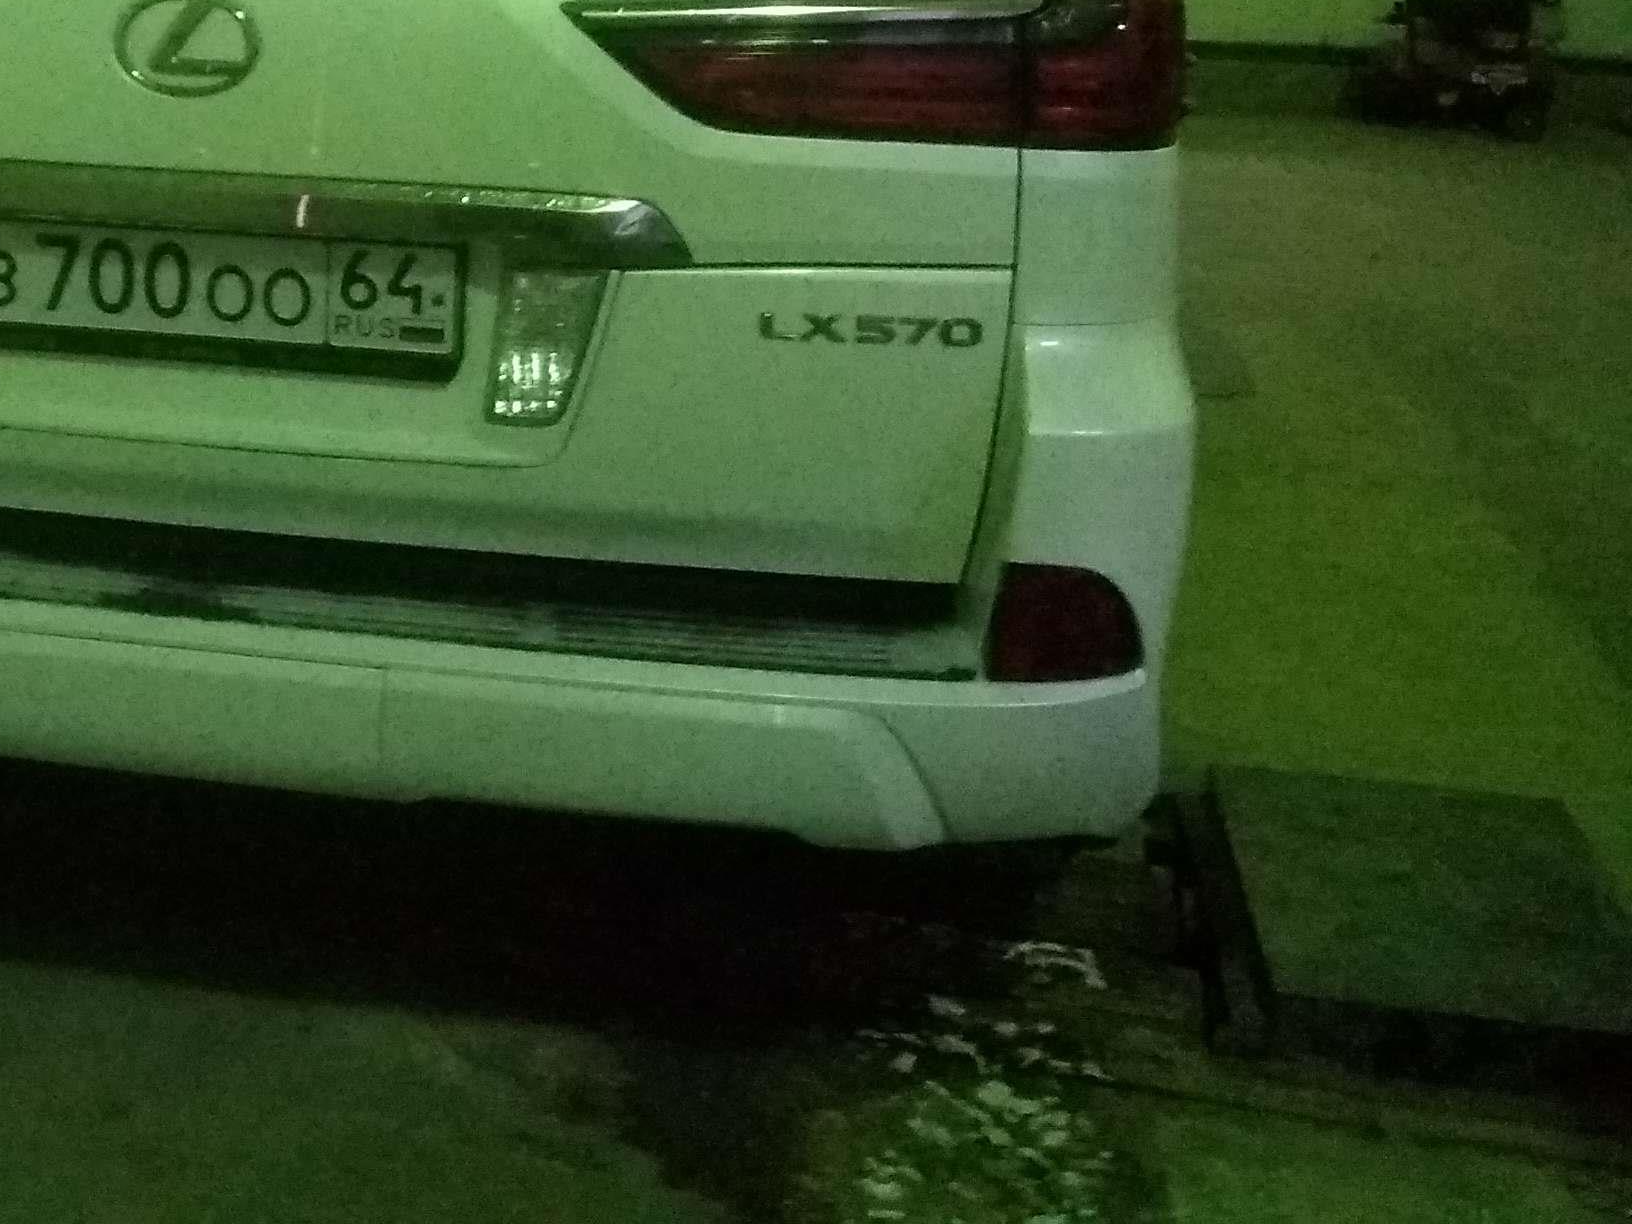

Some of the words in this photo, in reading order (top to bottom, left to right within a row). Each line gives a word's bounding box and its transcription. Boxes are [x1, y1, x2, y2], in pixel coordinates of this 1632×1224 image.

[341, 249, 422, 315] 64
[334, 314, 395, 339] RUS
[760, 312, 983, 347] LX570
